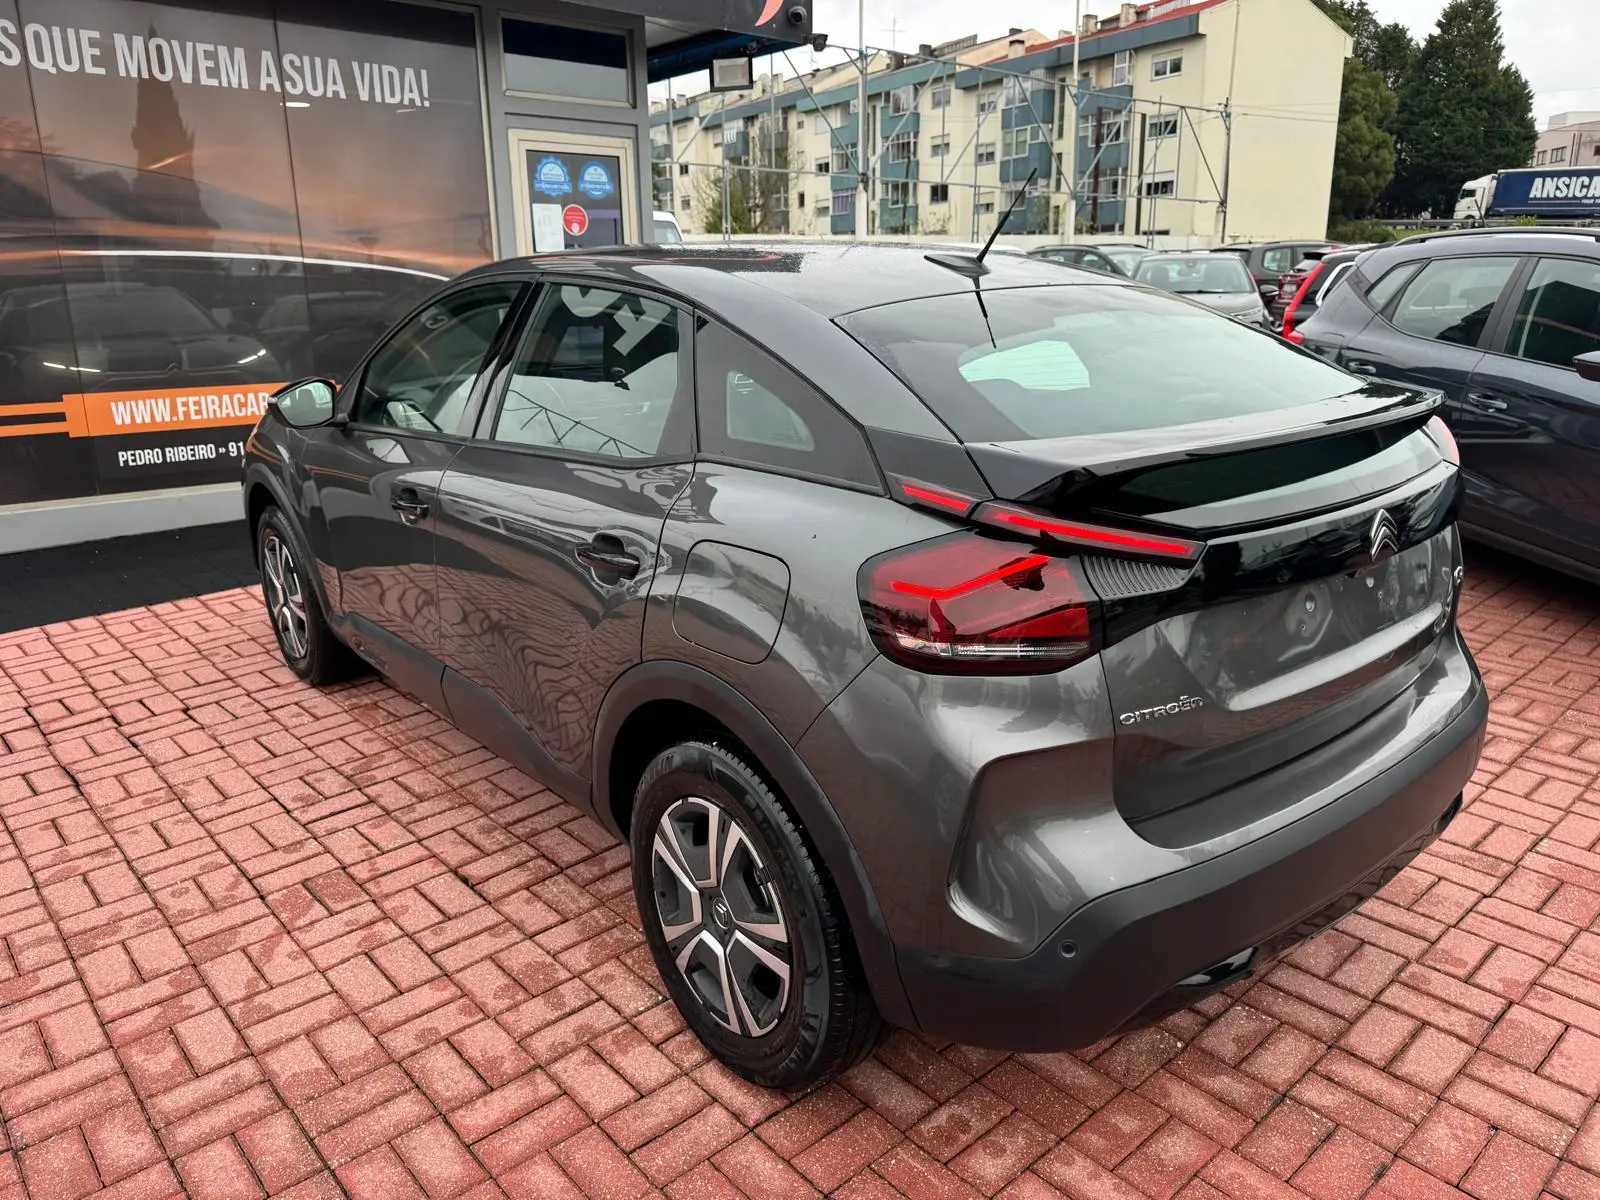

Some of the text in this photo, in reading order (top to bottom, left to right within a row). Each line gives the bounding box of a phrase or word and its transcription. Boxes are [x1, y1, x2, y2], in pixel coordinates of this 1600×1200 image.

[24, 23, 106, 75] QUE
[113, 32, 249, 90] MOVEM
[259, 50, 281, 93] A
[283, 53, 347, 100] SUA
[351, 61, 430, 108] VIDA!
[1529, 175, 1600, 198] ANSICA
[118, 450, 163, 467] PEDRO
[165, 443, 216, 463] RIBEIRO
